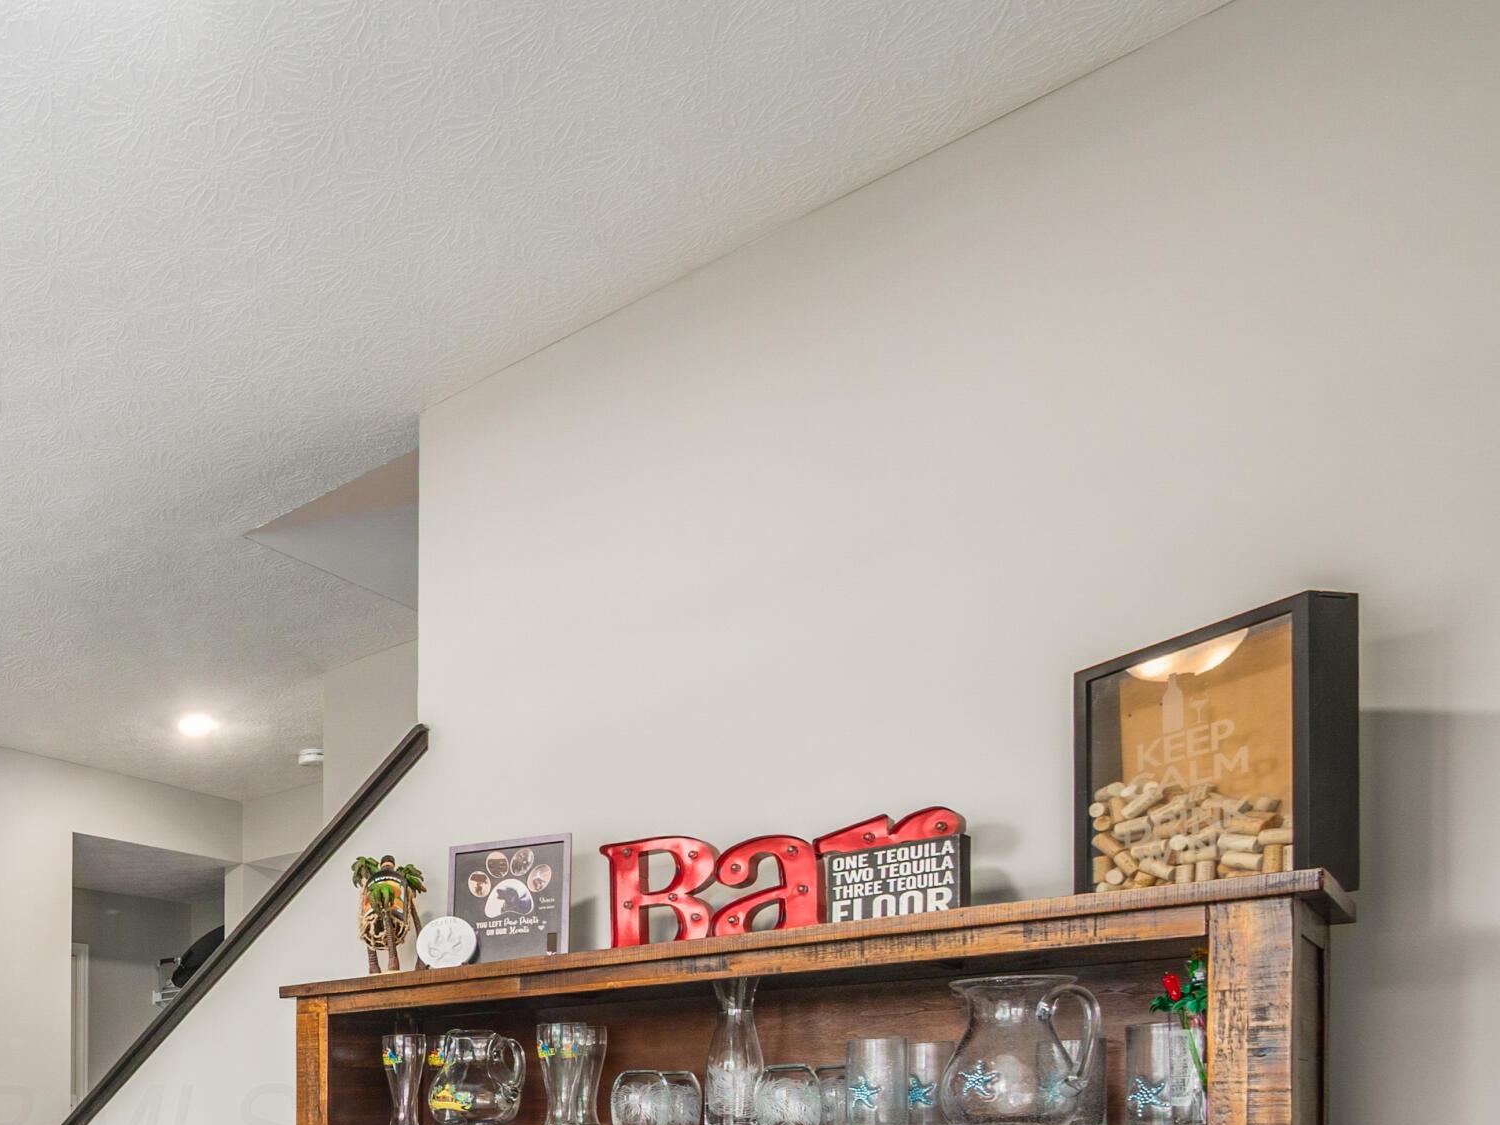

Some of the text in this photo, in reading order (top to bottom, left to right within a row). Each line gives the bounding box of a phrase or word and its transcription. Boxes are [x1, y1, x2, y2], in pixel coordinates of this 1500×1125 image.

[1136, 719, 1236, 771] KEEP
[1128, 745, 1250, 795] CALM
[832, 855, 954, 885] TWO TEQUILA
[833, 840, 955, 872] ONE TEQUILA
[832, 871, 955, 900] THREE TEQUILA
[832, 886, 953, 923] FLOOR
[476, 921, 488, 929] YOU
[488, 919, 502, 928] LEFT
